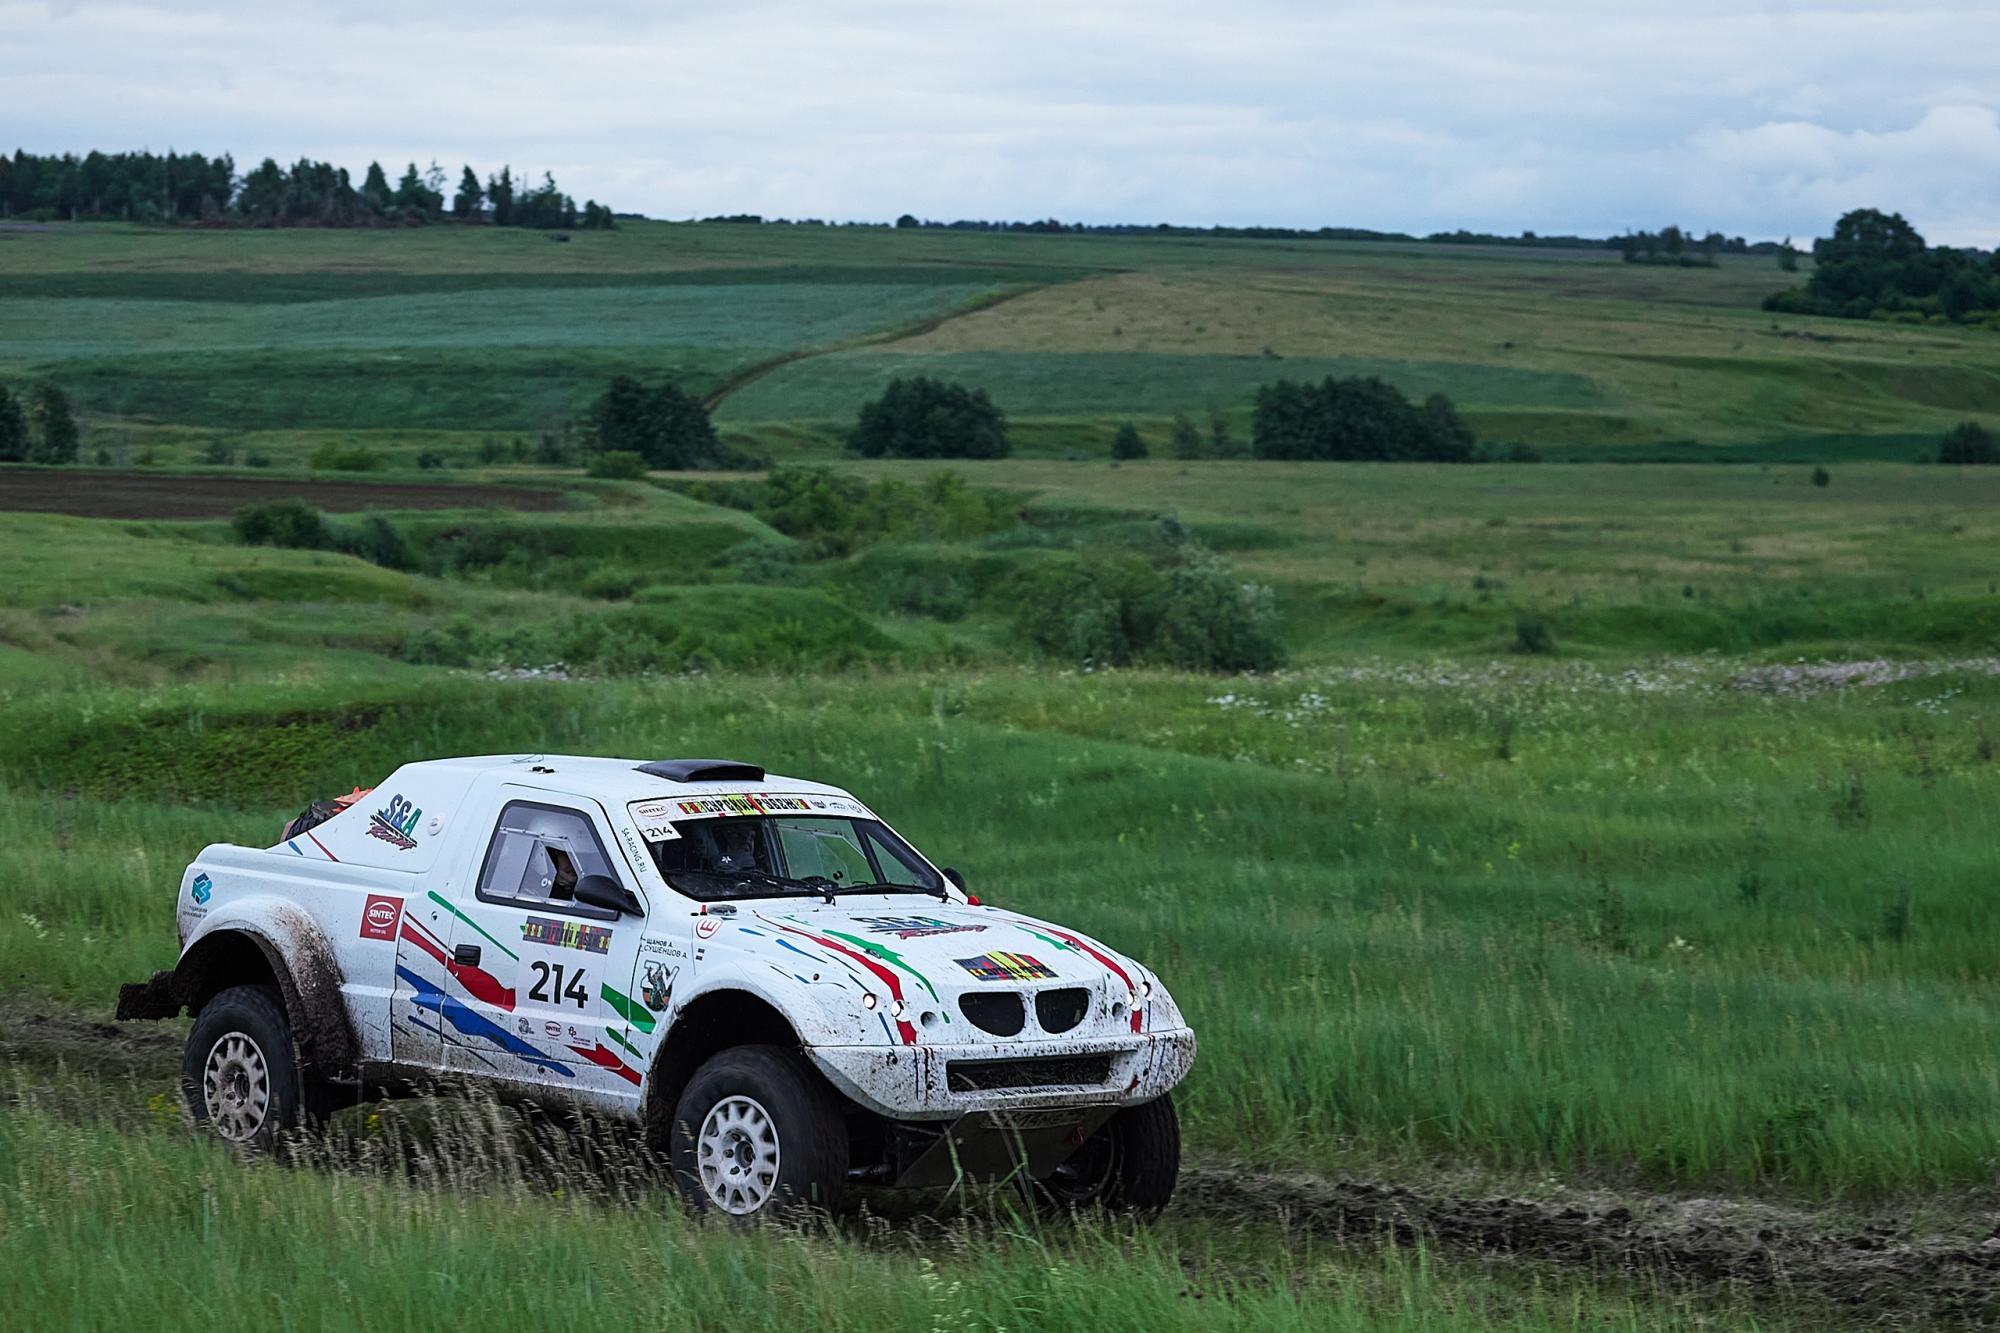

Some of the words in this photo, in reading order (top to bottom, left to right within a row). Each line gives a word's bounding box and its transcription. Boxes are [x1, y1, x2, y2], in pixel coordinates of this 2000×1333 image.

[646, 826, 672, 838] 214
[622, 827, 647, 873] SA-RACING.RU
[368, 909, 394, 919] SINTEC
[643, 944, 681, 958] СУШЕНЦОВ
[528, 960, 588, 1009] 214
